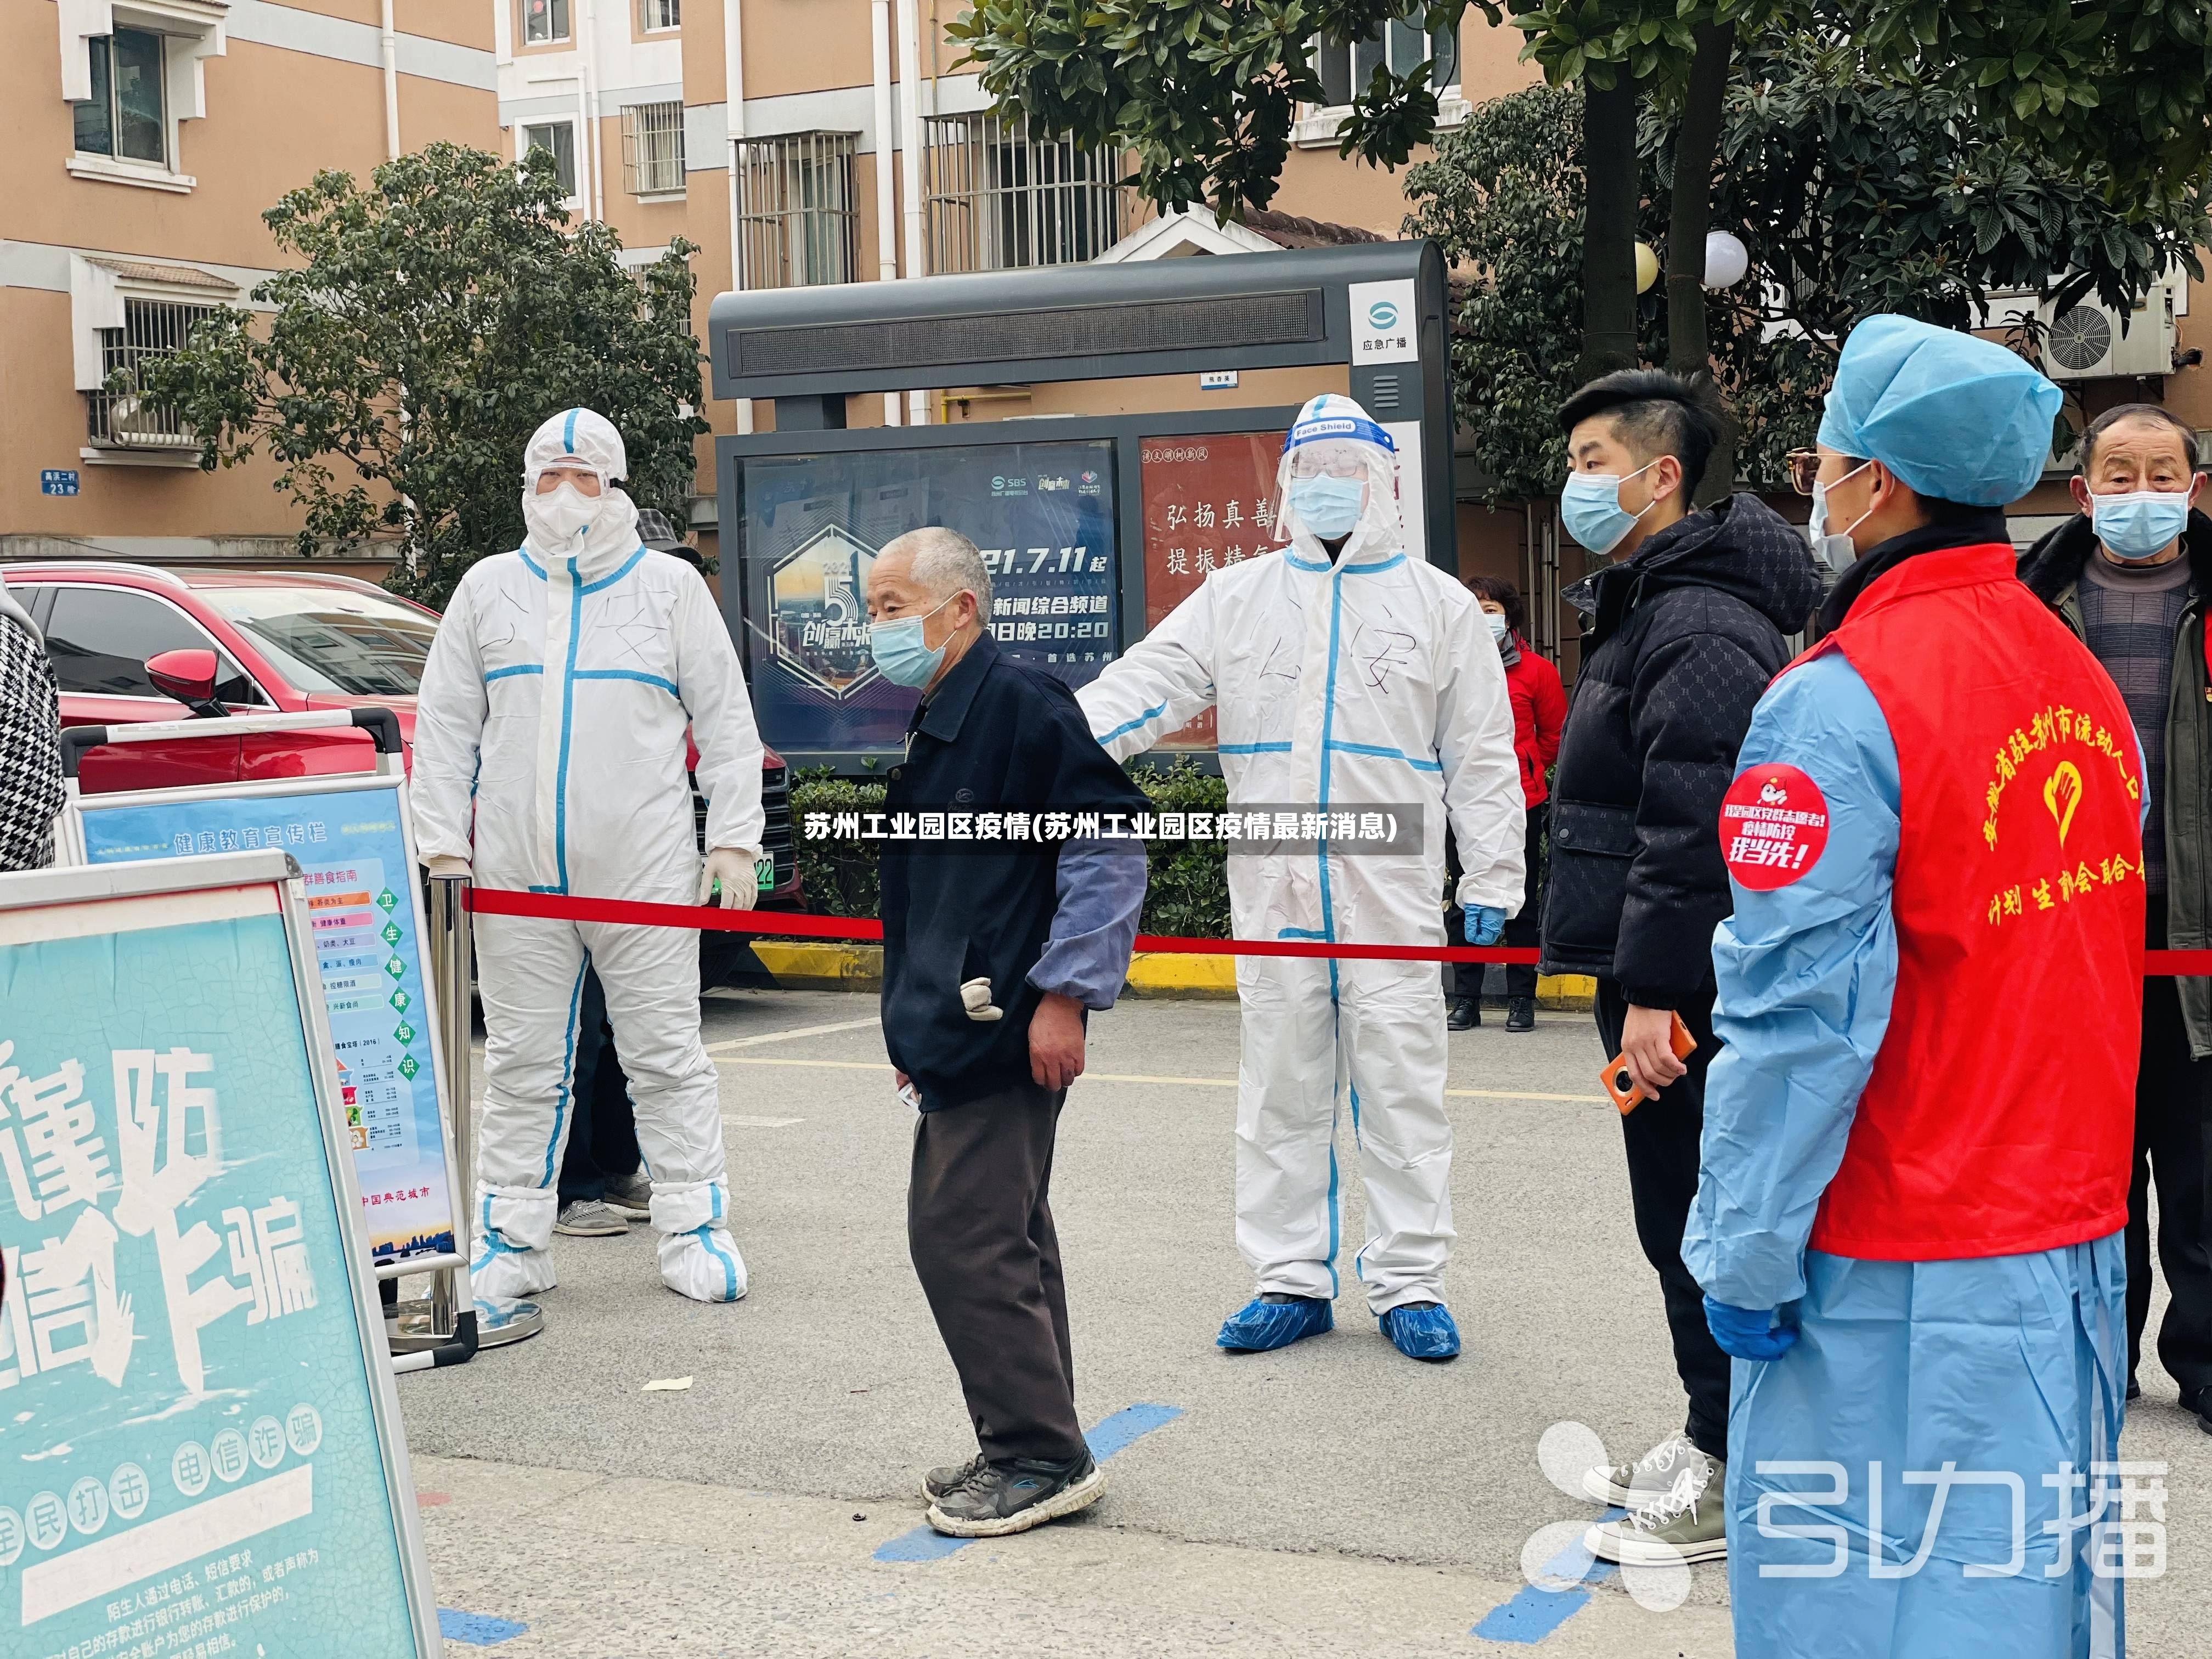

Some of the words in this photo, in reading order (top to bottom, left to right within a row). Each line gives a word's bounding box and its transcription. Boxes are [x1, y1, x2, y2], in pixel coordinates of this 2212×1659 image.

[1363, 337, 1407, 351] 应急广播
[1297, 427, 1317, 437] Face
[1142, 448, 1207, 462] 讲文明树新风
[50, 483, 64, 494] 23
[1008, 478, 1026, 487] SBS
[1166, 498, 1276, 531] 弘扬真善
[1089, 556, 1107, 572] 起
[992, 596, 1108, 616] 新闻综合频道
[1047, 651, 1112, 663] 首选苏州
[173, 821, 327, 854] 健康教育宣传栏
[1741, 821, 1796, 840] 疫情防控
[1729, 837, 1809, 869] 我当先!
[754, 858, 772, 885] 22
[320, 918, 346, 927] 健康体重
[381, 893, 415, 1074] 卫生健康知识
[0, 1196, 319, 1396] 信诈骗
[178, 1413, 317, 1486] 电信诈骗
